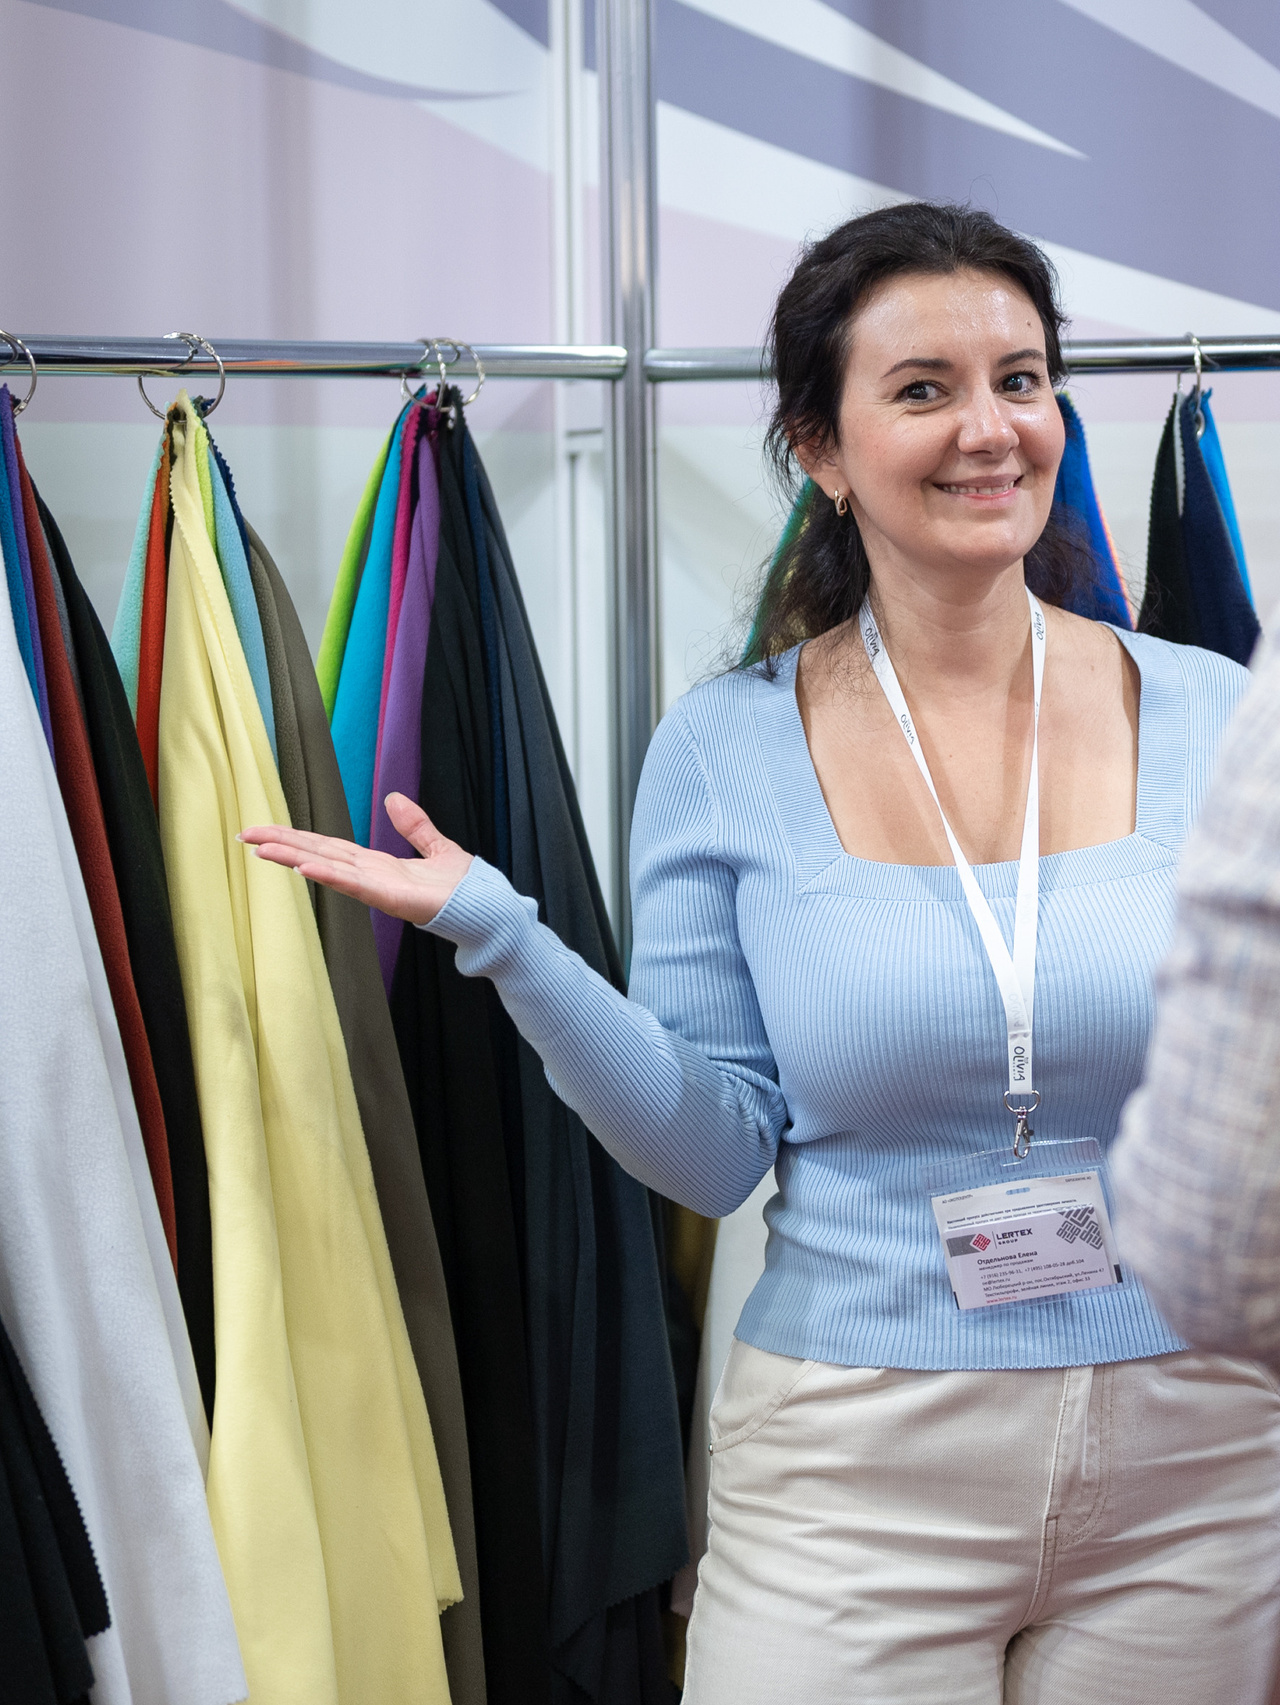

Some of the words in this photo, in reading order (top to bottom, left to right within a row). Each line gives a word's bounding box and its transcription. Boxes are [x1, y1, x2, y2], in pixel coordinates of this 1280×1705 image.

[1013, 1046, 1026, 1082] OLIVIA
[996, 1228, 1033, 1240] LERTEX
[977, 1254, 1017, 1266] Отдельнова
[1018, 1251, 1038, 1259] Елена
